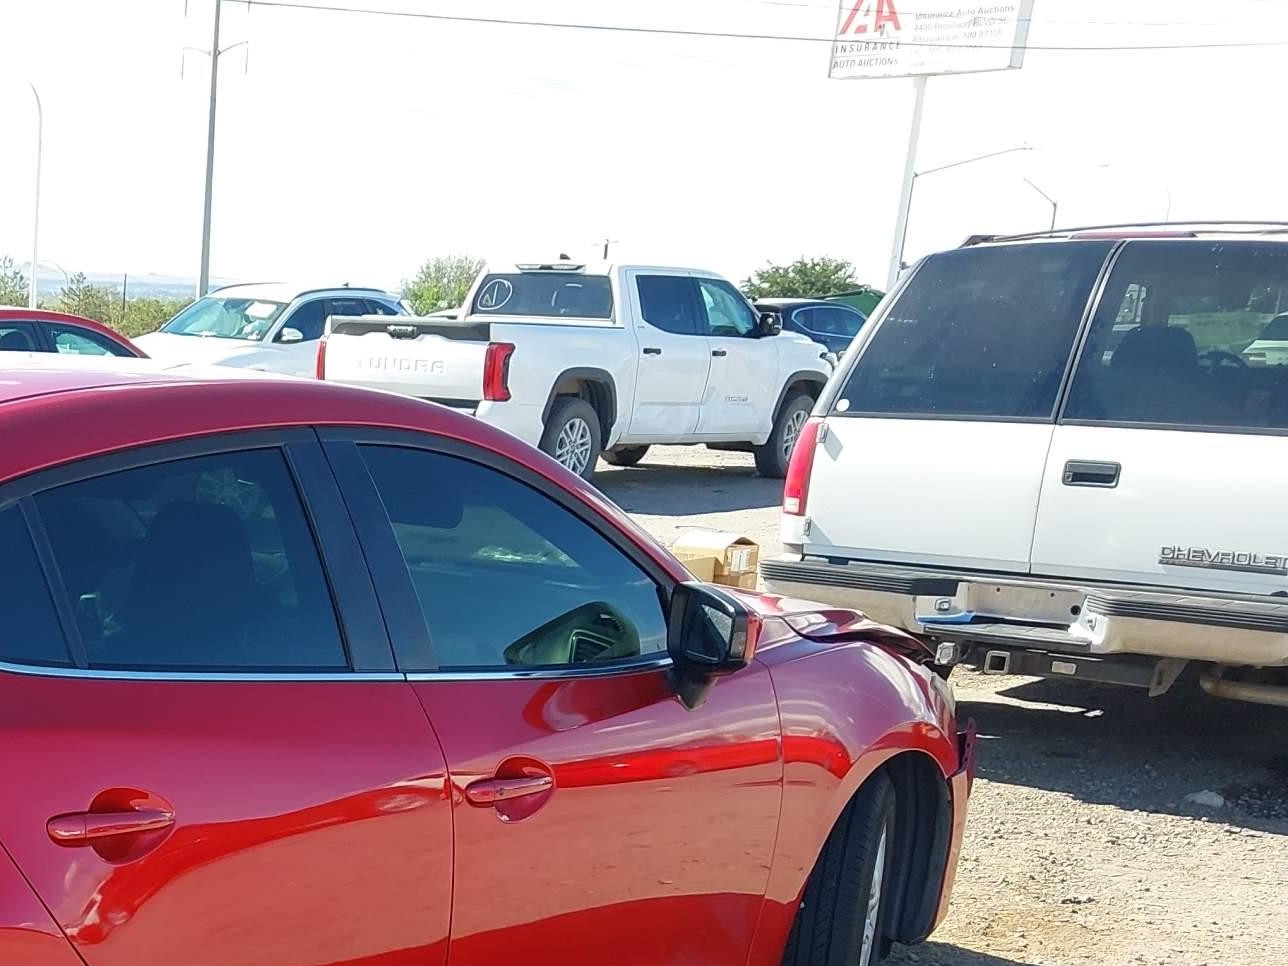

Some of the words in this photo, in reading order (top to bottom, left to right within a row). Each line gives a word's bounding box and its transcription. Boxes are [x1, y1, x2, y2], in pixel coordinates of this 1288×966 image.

[956, 8, 976, 17] Auto
[977, 6, 1015, 15] Auctions
[835, 41, 902, 54] INSURANCE
[831, 59, 856, 70] AUTO
[857, 57, 899, 67] AUCTIONS
[1159, 545, 1288, 570] CHEVROLET
